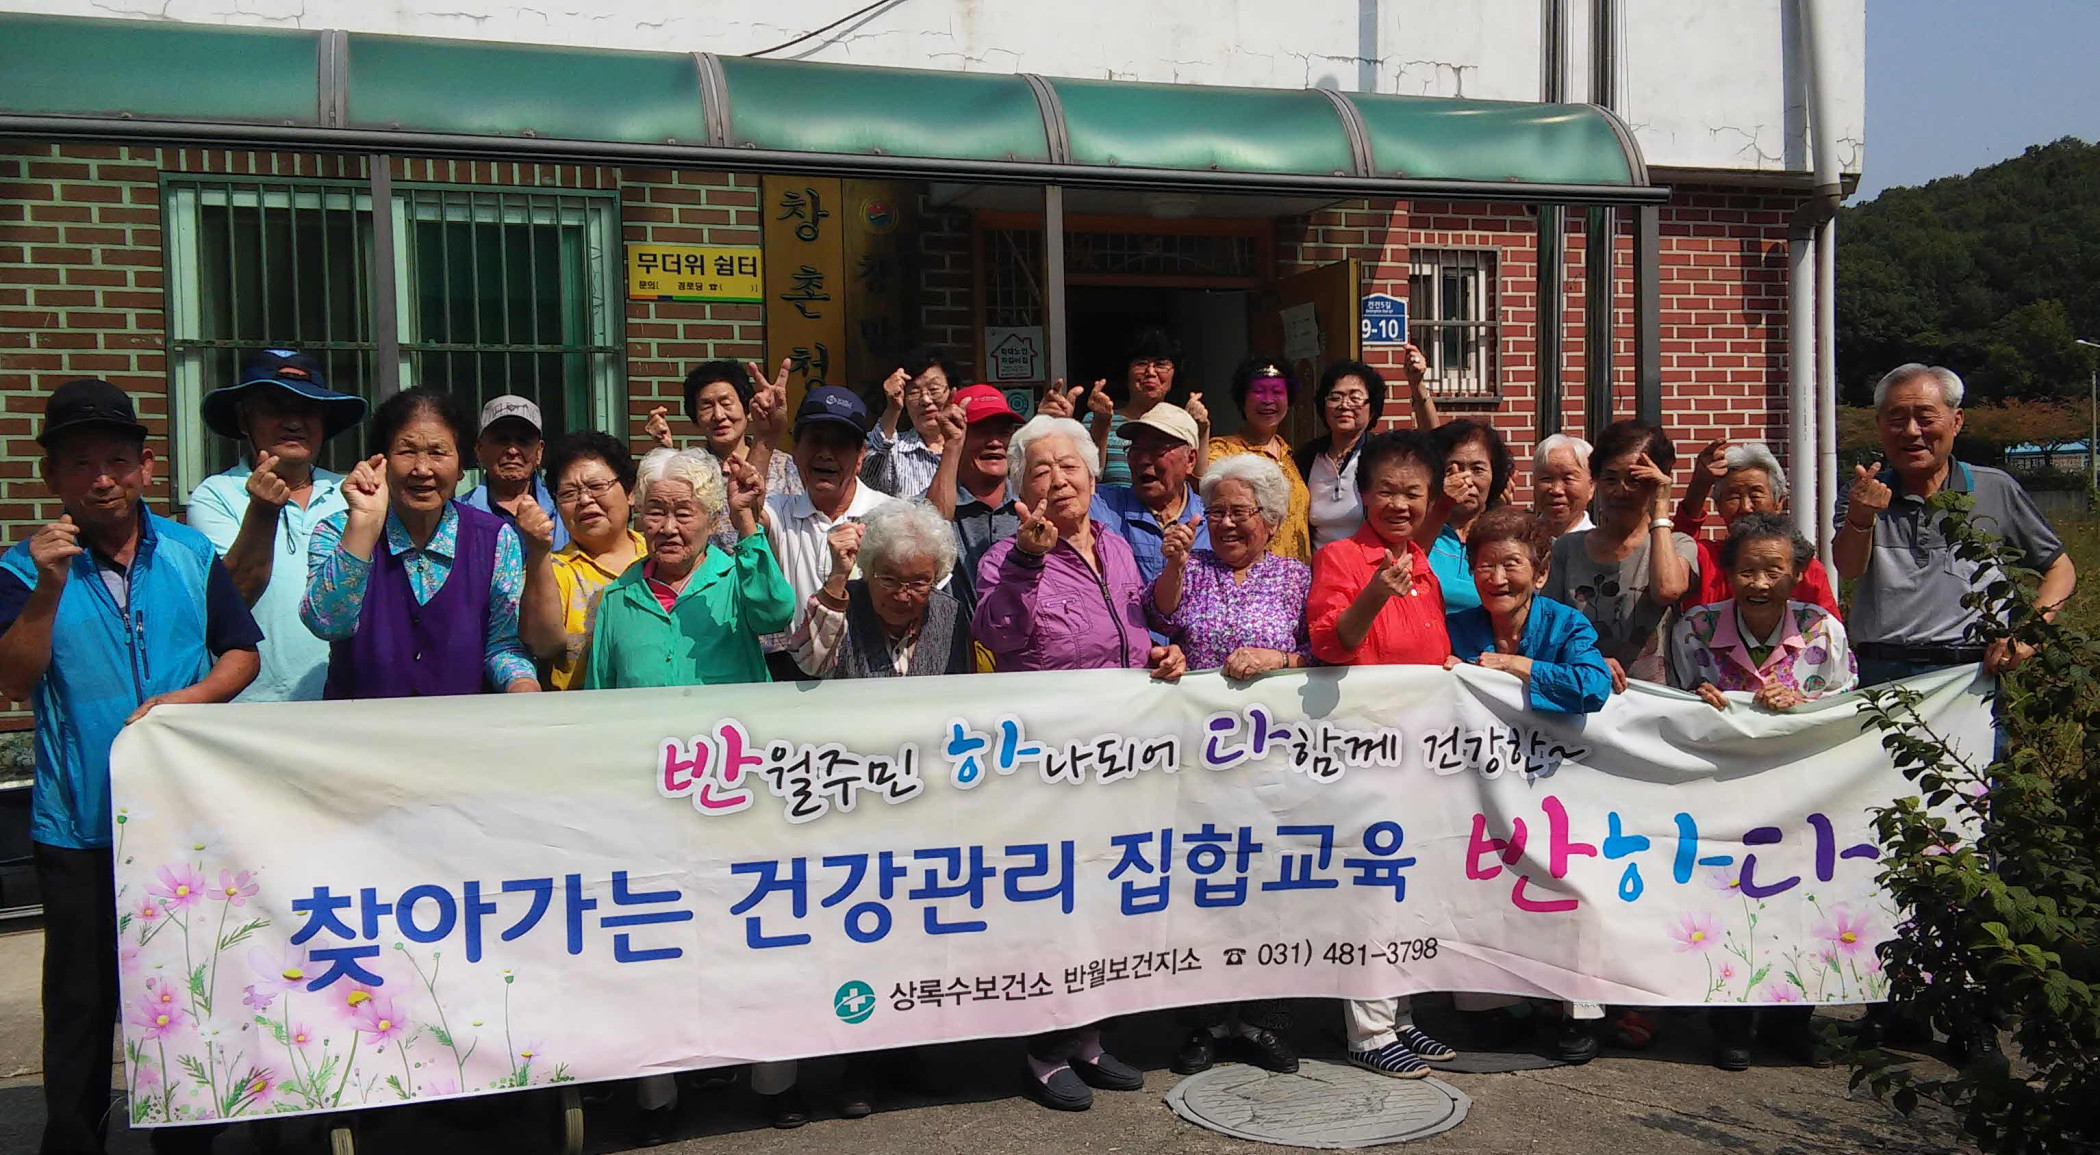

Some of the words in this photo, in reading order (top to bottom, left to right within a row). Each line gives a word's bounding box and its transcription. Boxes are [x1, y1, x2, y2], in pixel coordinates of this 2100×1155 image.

[637, 252, 705, 276] 무더위
[713, 254, 758, 278] 쉼터
[677, 281, 704, 291] 경로당
[1362, 318, 1399, 339] 9-10
[664, 724, 919, 818] 반월주민
[948, 719, 1174, 784] 하나되어
[1205, 709, 1398, 777] 다함께
[290, 870, 694, 993] 찾아가는
[729, 840, 1076, 944] 건강관리
[1107, 820, 1417, 917] 집합교육
[1465, 795, 1880, 913] 반하다
[888, 971, 1054, 1011] 상록수보건소
[1063, 947, 1203, 995] 반월보건지소
[1257, 938, 1313, 967] 031)
[1323, 936, 1438, 966] 481-3798
